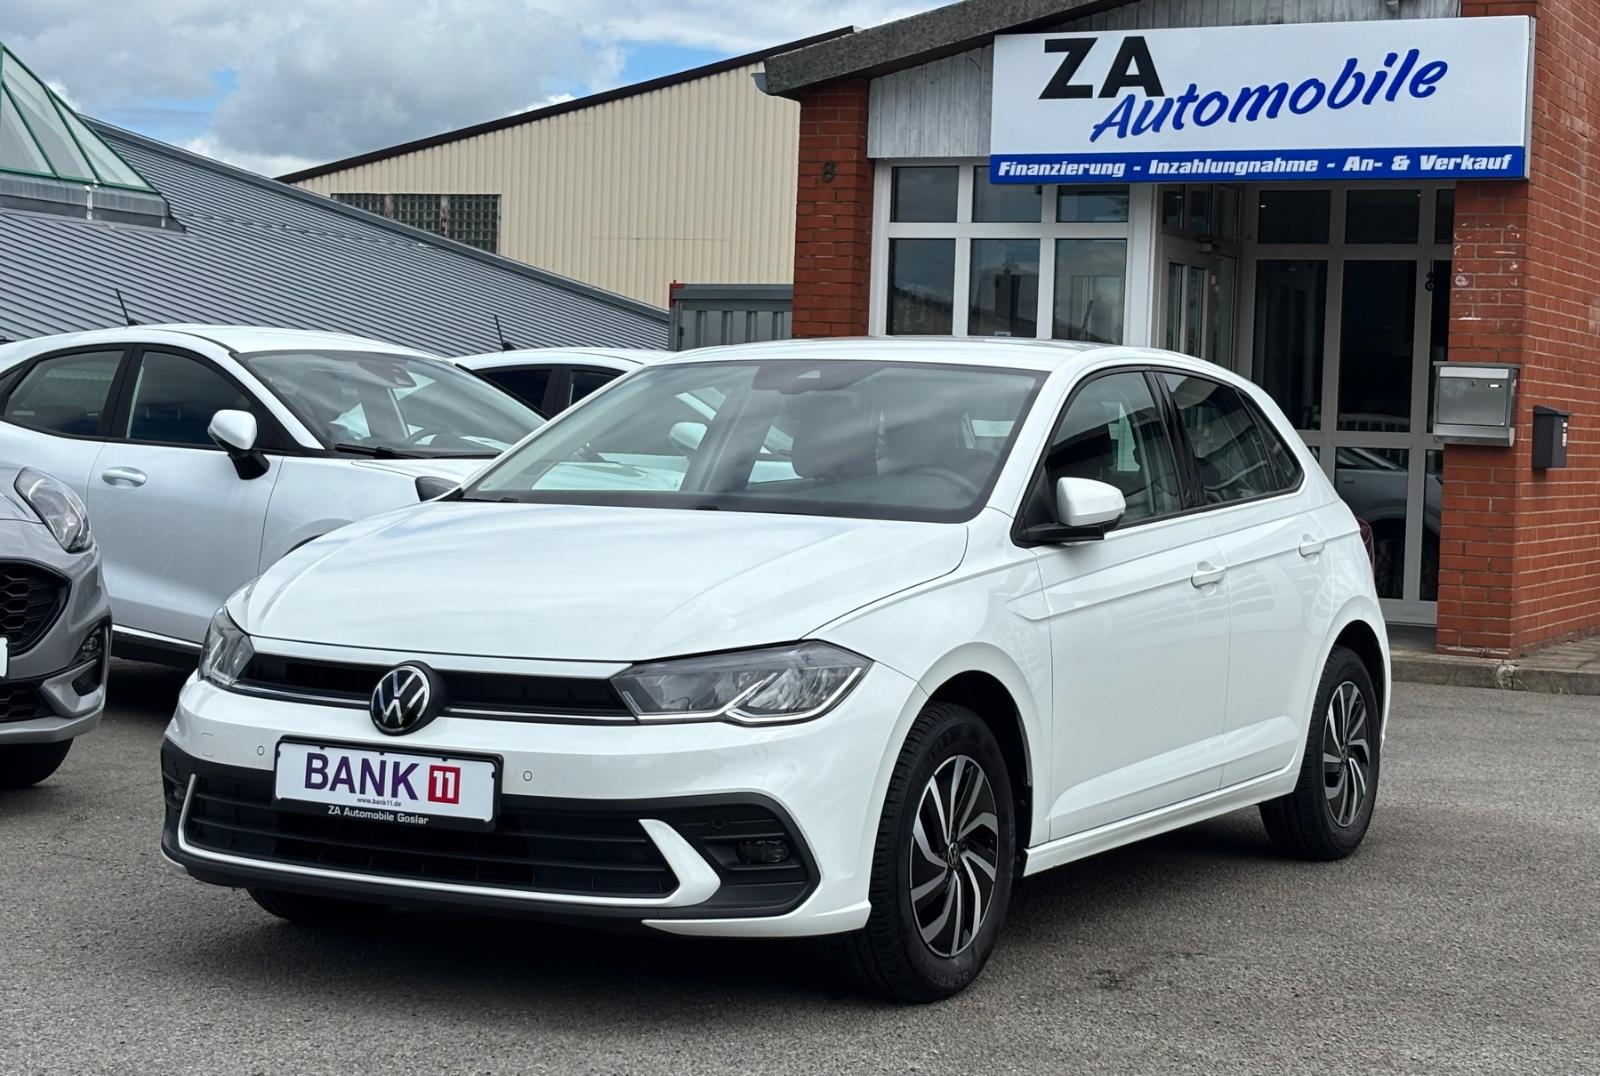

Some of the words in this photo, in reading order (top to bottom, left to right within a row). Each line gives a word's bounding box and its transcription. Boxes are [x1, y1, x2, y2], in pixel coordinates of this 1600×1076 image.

[1039, 36, 1165, 99] ZA
[1089, 48, 1448, 143] Automobile
[998, 161, 1126, 178] Finanzierung
[1148, 157, 1319, 176] Inzahlungnahme
[1342, 156, 1383, 172] An-
[1391, 155, 1411, 171] &
[1420, 153, 1513, 171] Verkauf
[304, 752, 420, 801] BANK
[433, 770, 456, 799] 11
[328, 805, 341, 815] ZA
[343, 807, 395, 822] Automobile
[397, 813, 430, 825] Goslar
[357, 797, 402, 807] www.bank11.de
